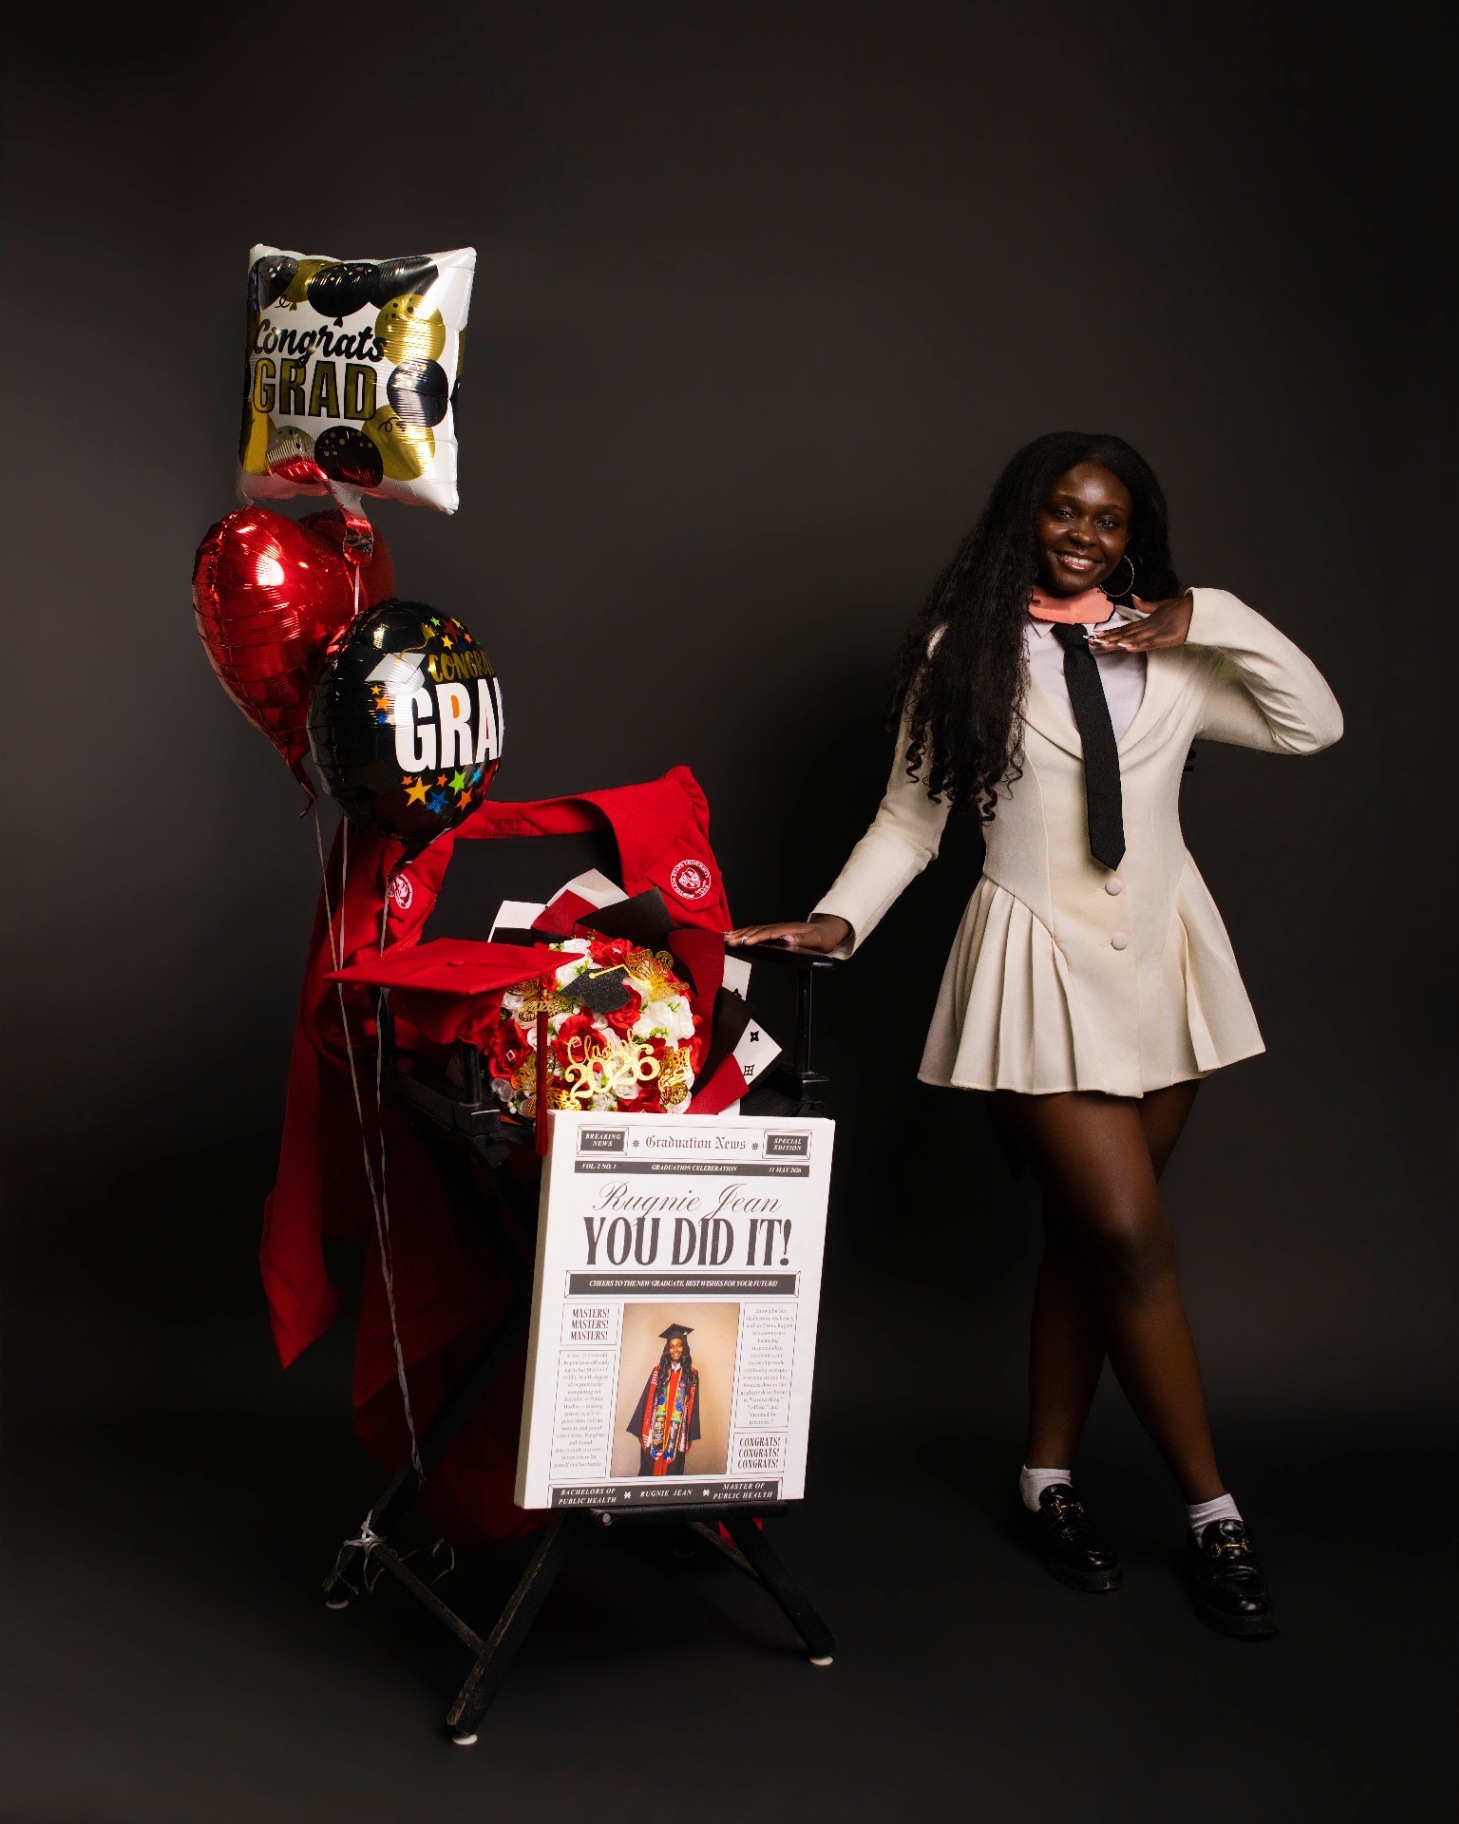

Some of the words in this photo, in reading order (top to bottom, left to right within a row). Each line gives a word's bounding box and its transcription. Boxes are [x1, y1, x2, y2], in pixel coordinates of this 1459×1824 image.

[253, 319, 387, 368] Congrats
[253, 358, 378, 421] GRAD
[564, 1035, 613, 1066] Class
[564, 1043, 661, 1101] 2026
[645, 1135, 711, 1150] Graduation
[715, 1136, 747, 1150] News
[592, 1181, 702, 1227] Rugnie
[697, 1183, 783, 1227] Jean
[583, 1217, 661, 1266] YOU
[671, 1218, 734, 1266] DID
[746, 1218, 792, 1266] IT!
[572, 1309, 610, 1318] MASTERS!
[572, 1320, 609, 1329] MASTERS!
[571, 1330, 608, 1340] MASTERS!
[740, 1437, 781, 1447] CONGRATS!
[738, 1448, 780, 1458] CONGRATS!
[737, 1459, 779, 1469] CONGRATS!
[560, 1488, 605, 1496] BACHELORS
[640, 1489, 670, 1498] RUGNIE
[713, 1492, 741, 1500] PUBLIC
